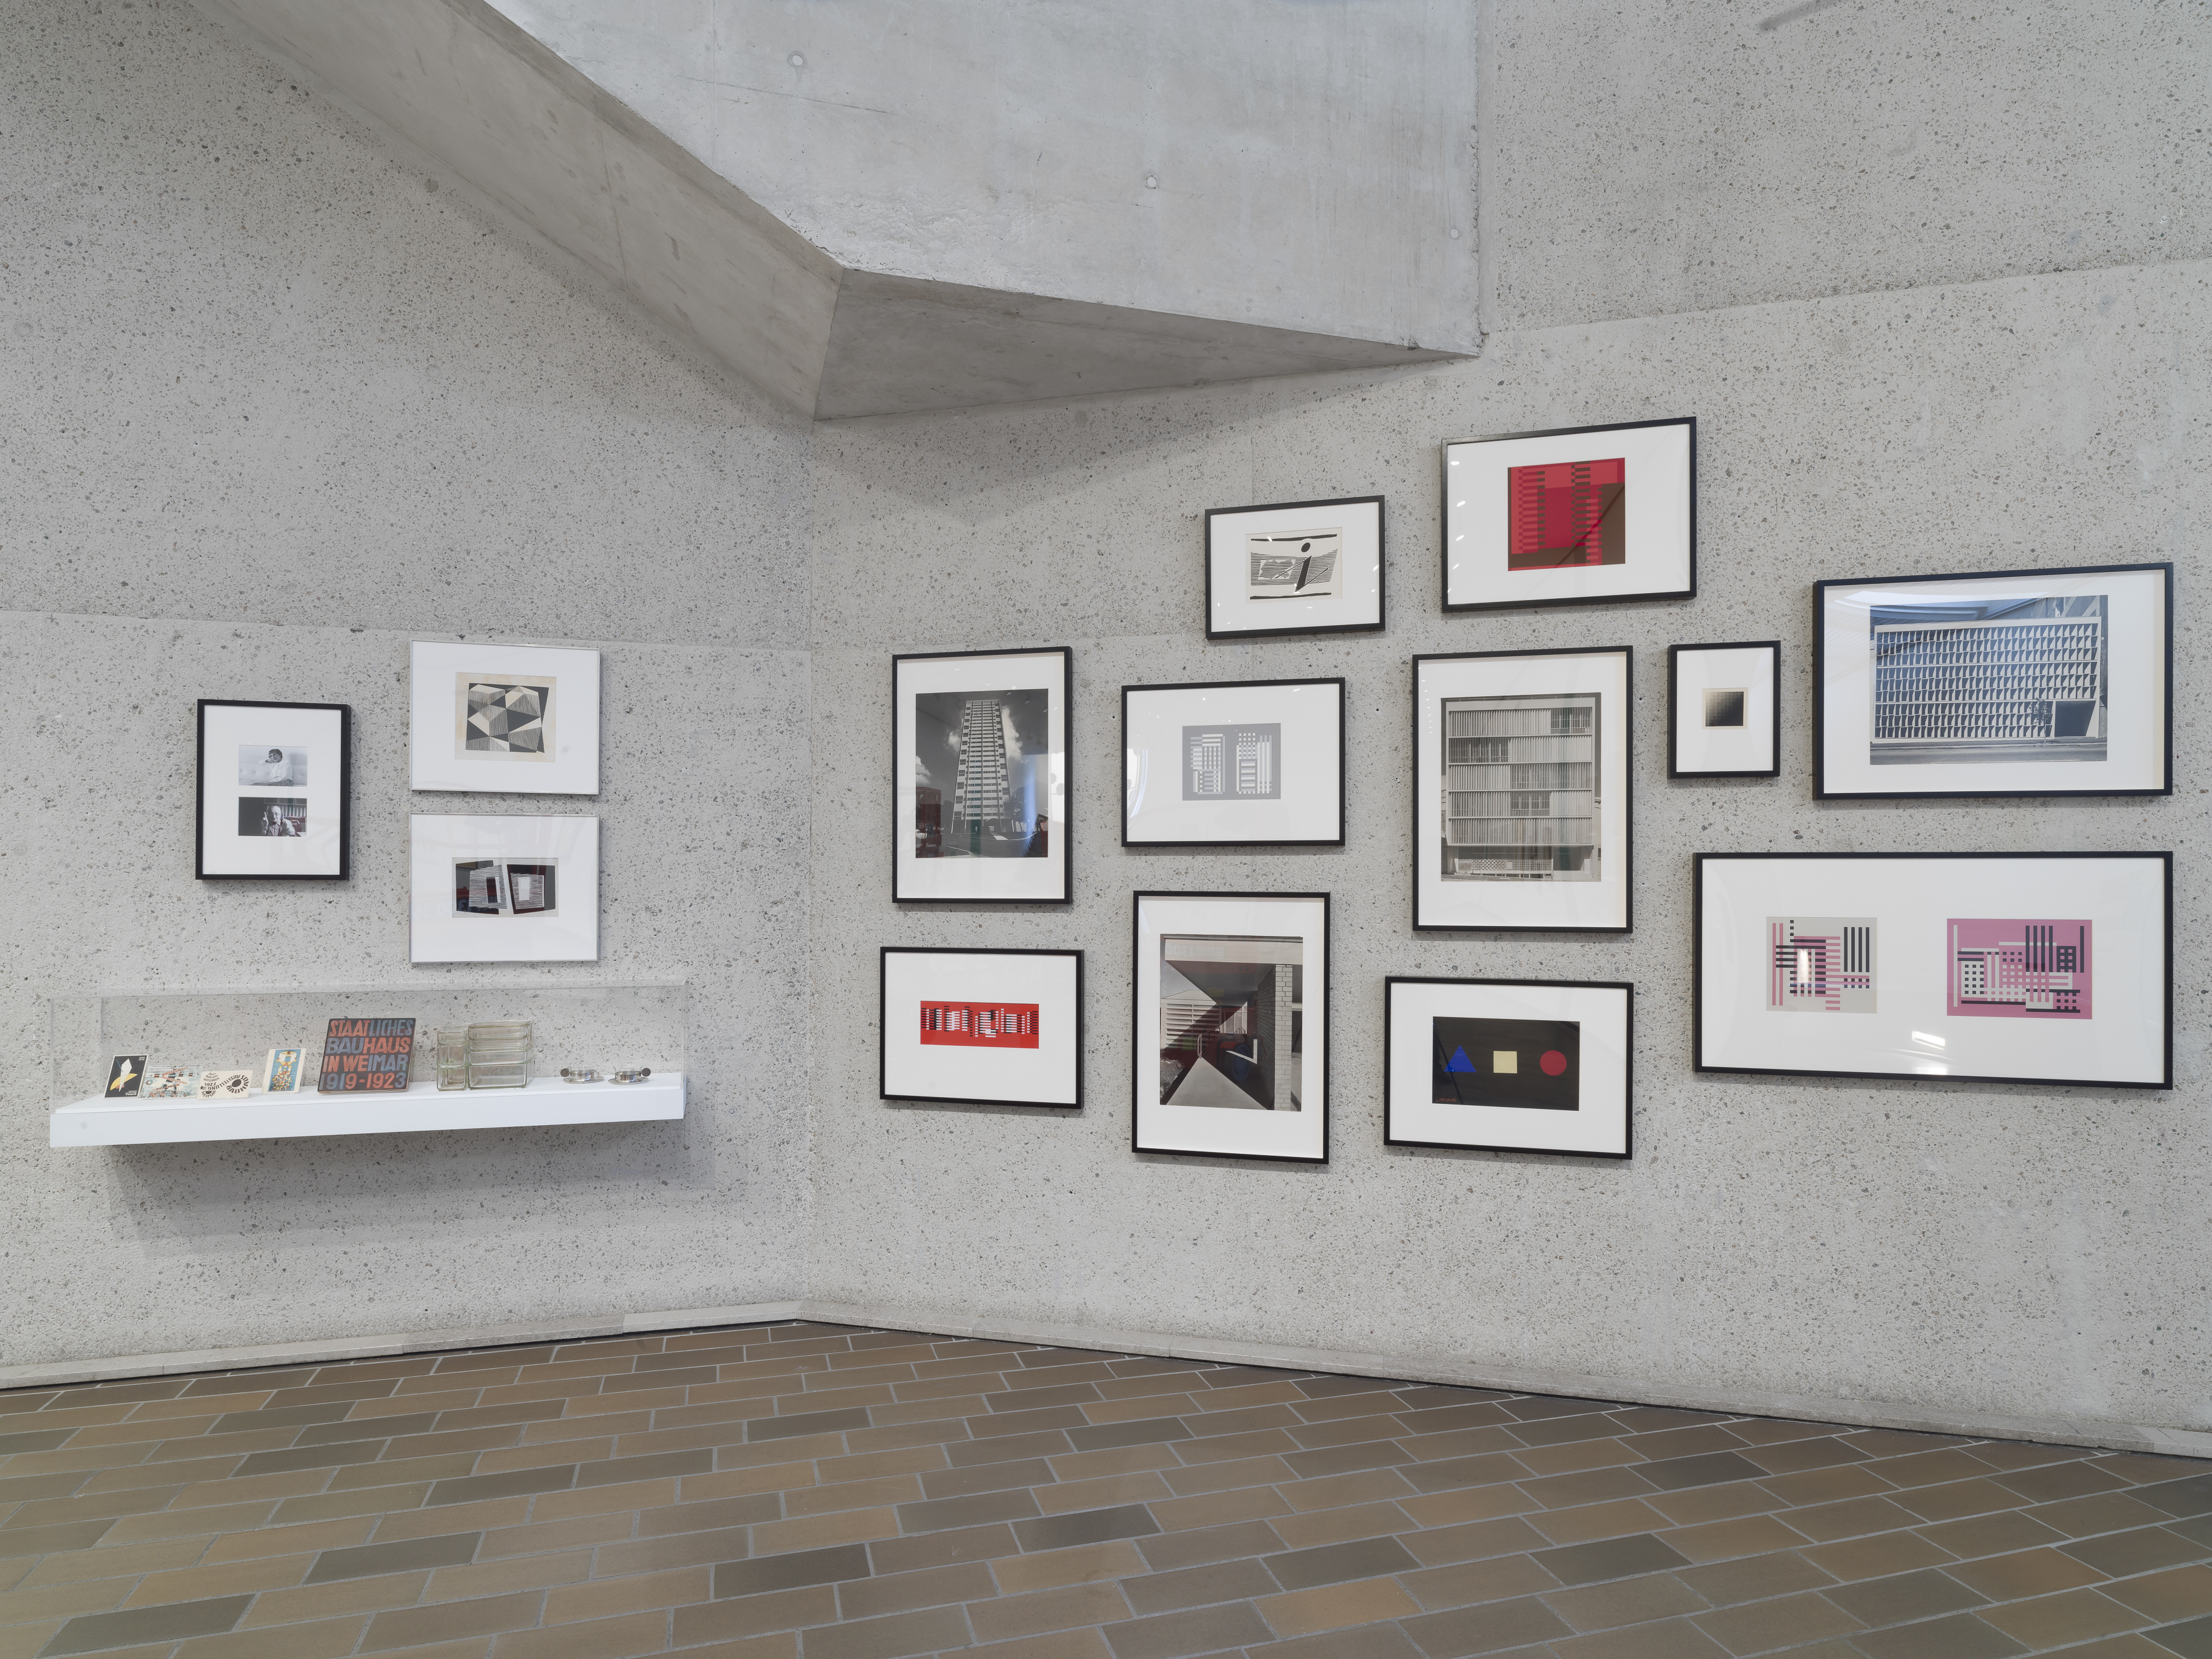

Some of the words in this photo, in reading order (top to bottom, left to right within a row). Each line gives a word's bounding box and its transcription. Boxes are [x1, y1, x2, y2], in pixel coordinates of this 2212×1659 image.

[329, 1020, 414, 1037] STAATLICHES
[325, 1037, 411, 1054] BAUHAUS
[322, 1055, 340, 1073] IN
[343, 1055, 409, 1072] WEIMAR
[226, 1075, 249, 1094] BAUHAUS
